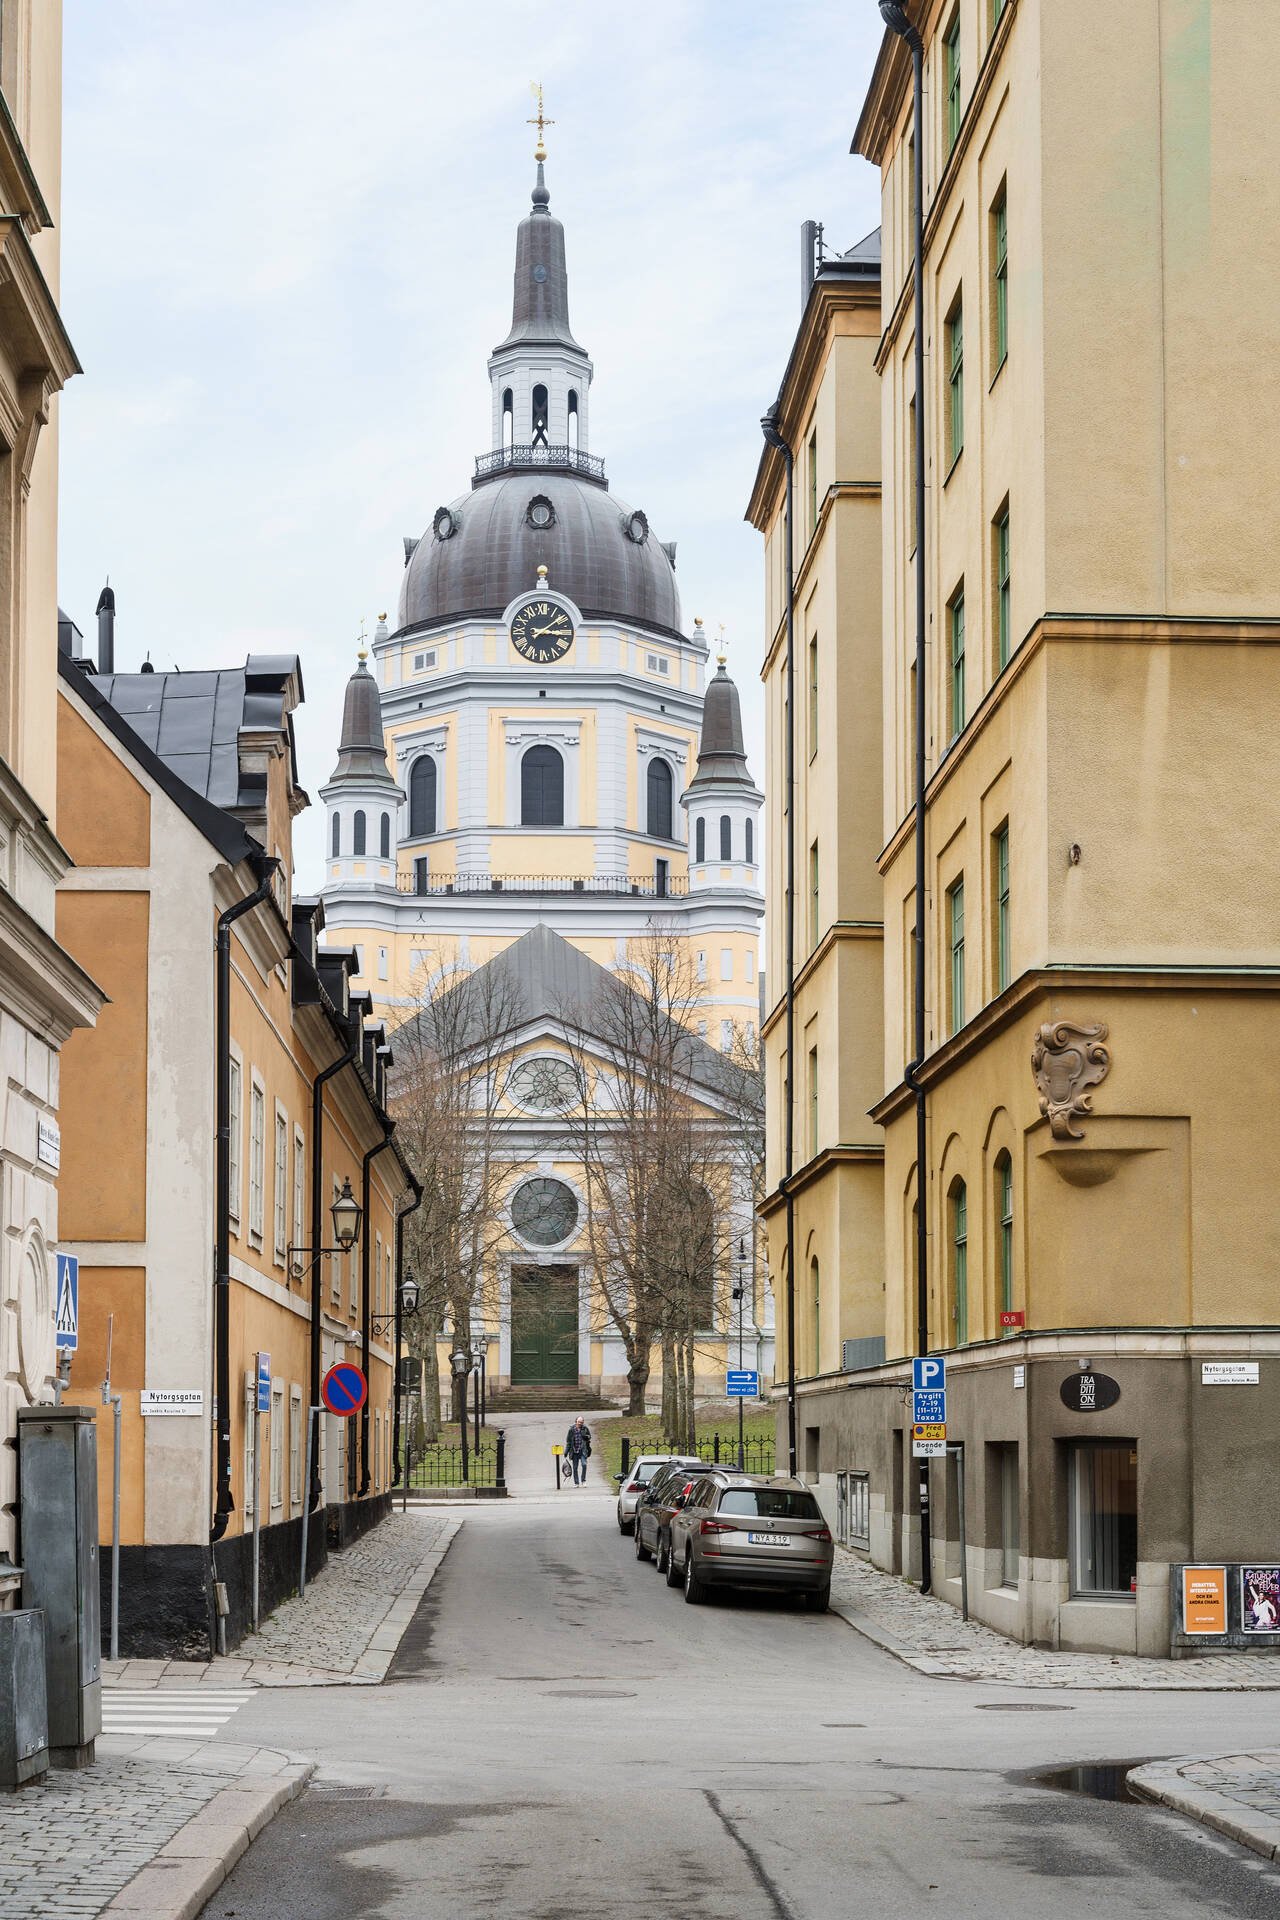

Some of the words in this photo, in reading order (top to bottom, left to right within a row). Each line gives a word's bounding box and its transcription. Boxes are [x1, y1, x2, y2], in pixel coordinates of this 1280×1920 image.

[921, 1361, 940, 1387] P
[1204, 1365, 1246, 1374] Nytorgsgatan
[1080, 1375, 1095, 1384] TRA
[149, 1392, 201, 1402] Nytorgsgatan
[917, 1406, 941, 1414] (11-17)
[755, 1534, 770, 1542] NYA
[771, 1535, 787, 1543] 319
[1245, 1572, 1280, 1580] SATURDAY
